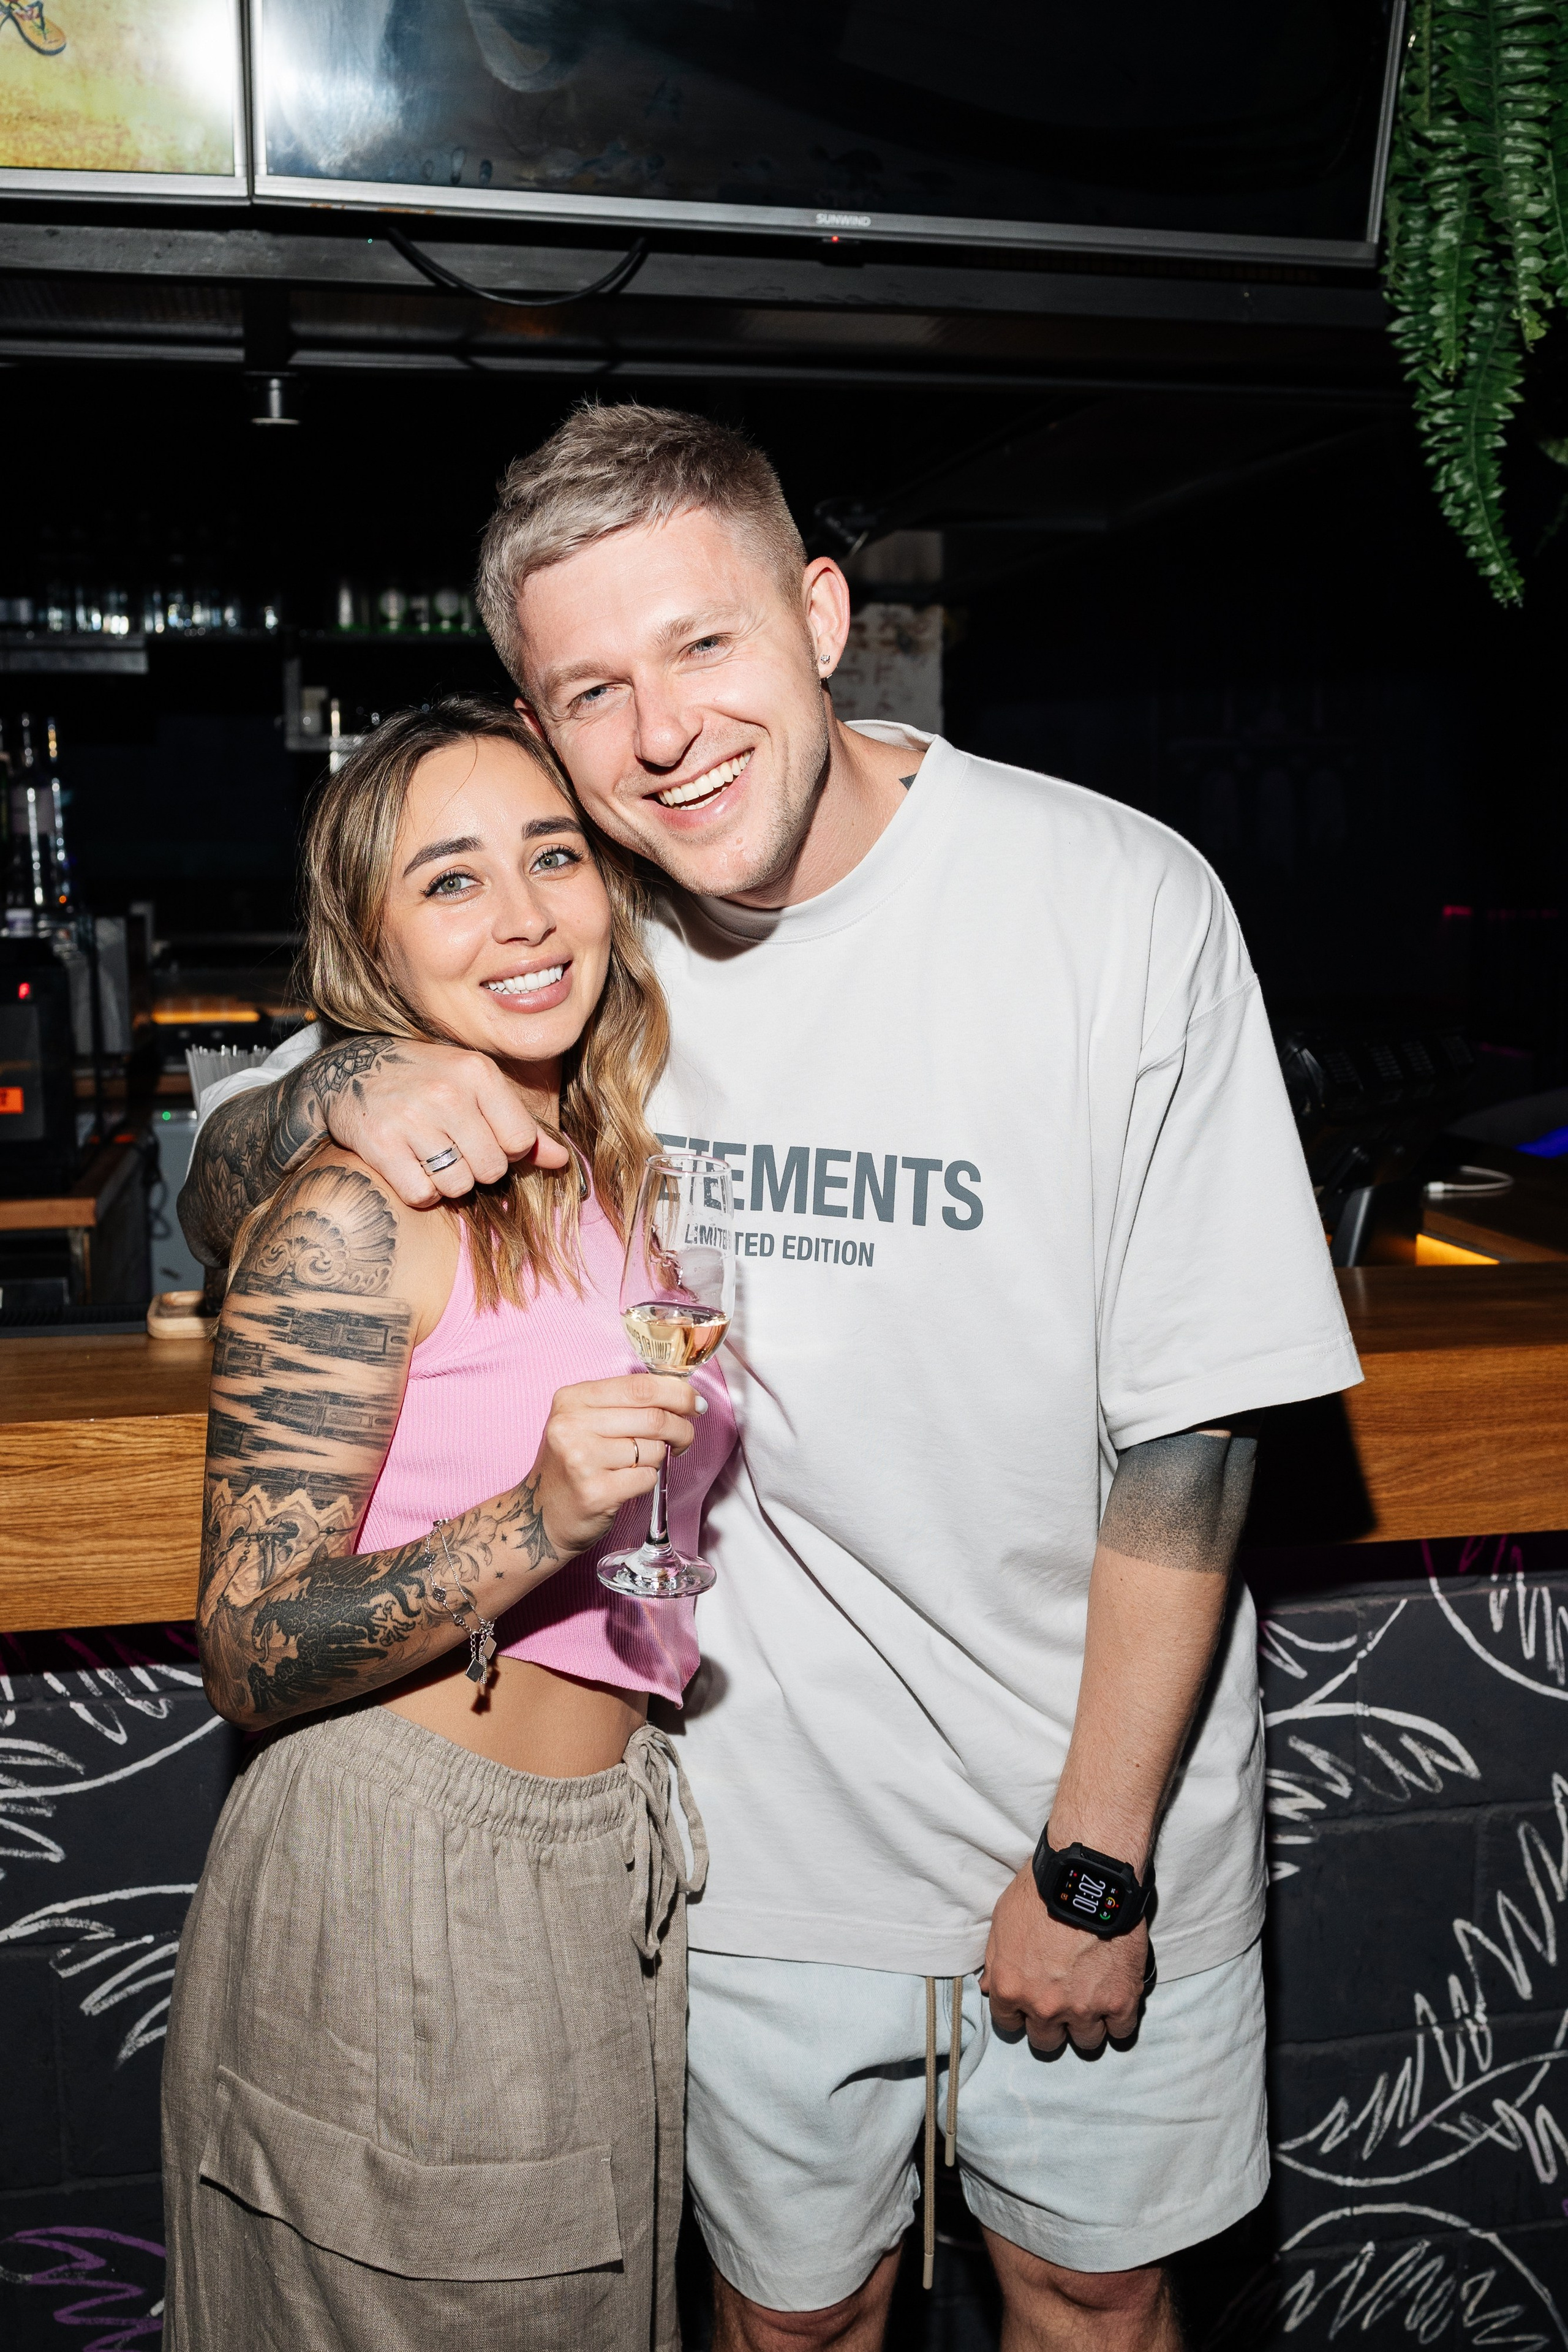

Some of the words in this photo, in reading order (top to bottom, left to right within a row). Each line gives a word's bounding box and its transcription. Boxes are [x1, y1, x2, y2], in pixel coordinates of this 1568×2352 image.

[816, 213, 871, 227] SUNWIND
[782, 1235, 875, 1267] EDITION
[1072, 1873, 1106, 1914] 20:10
